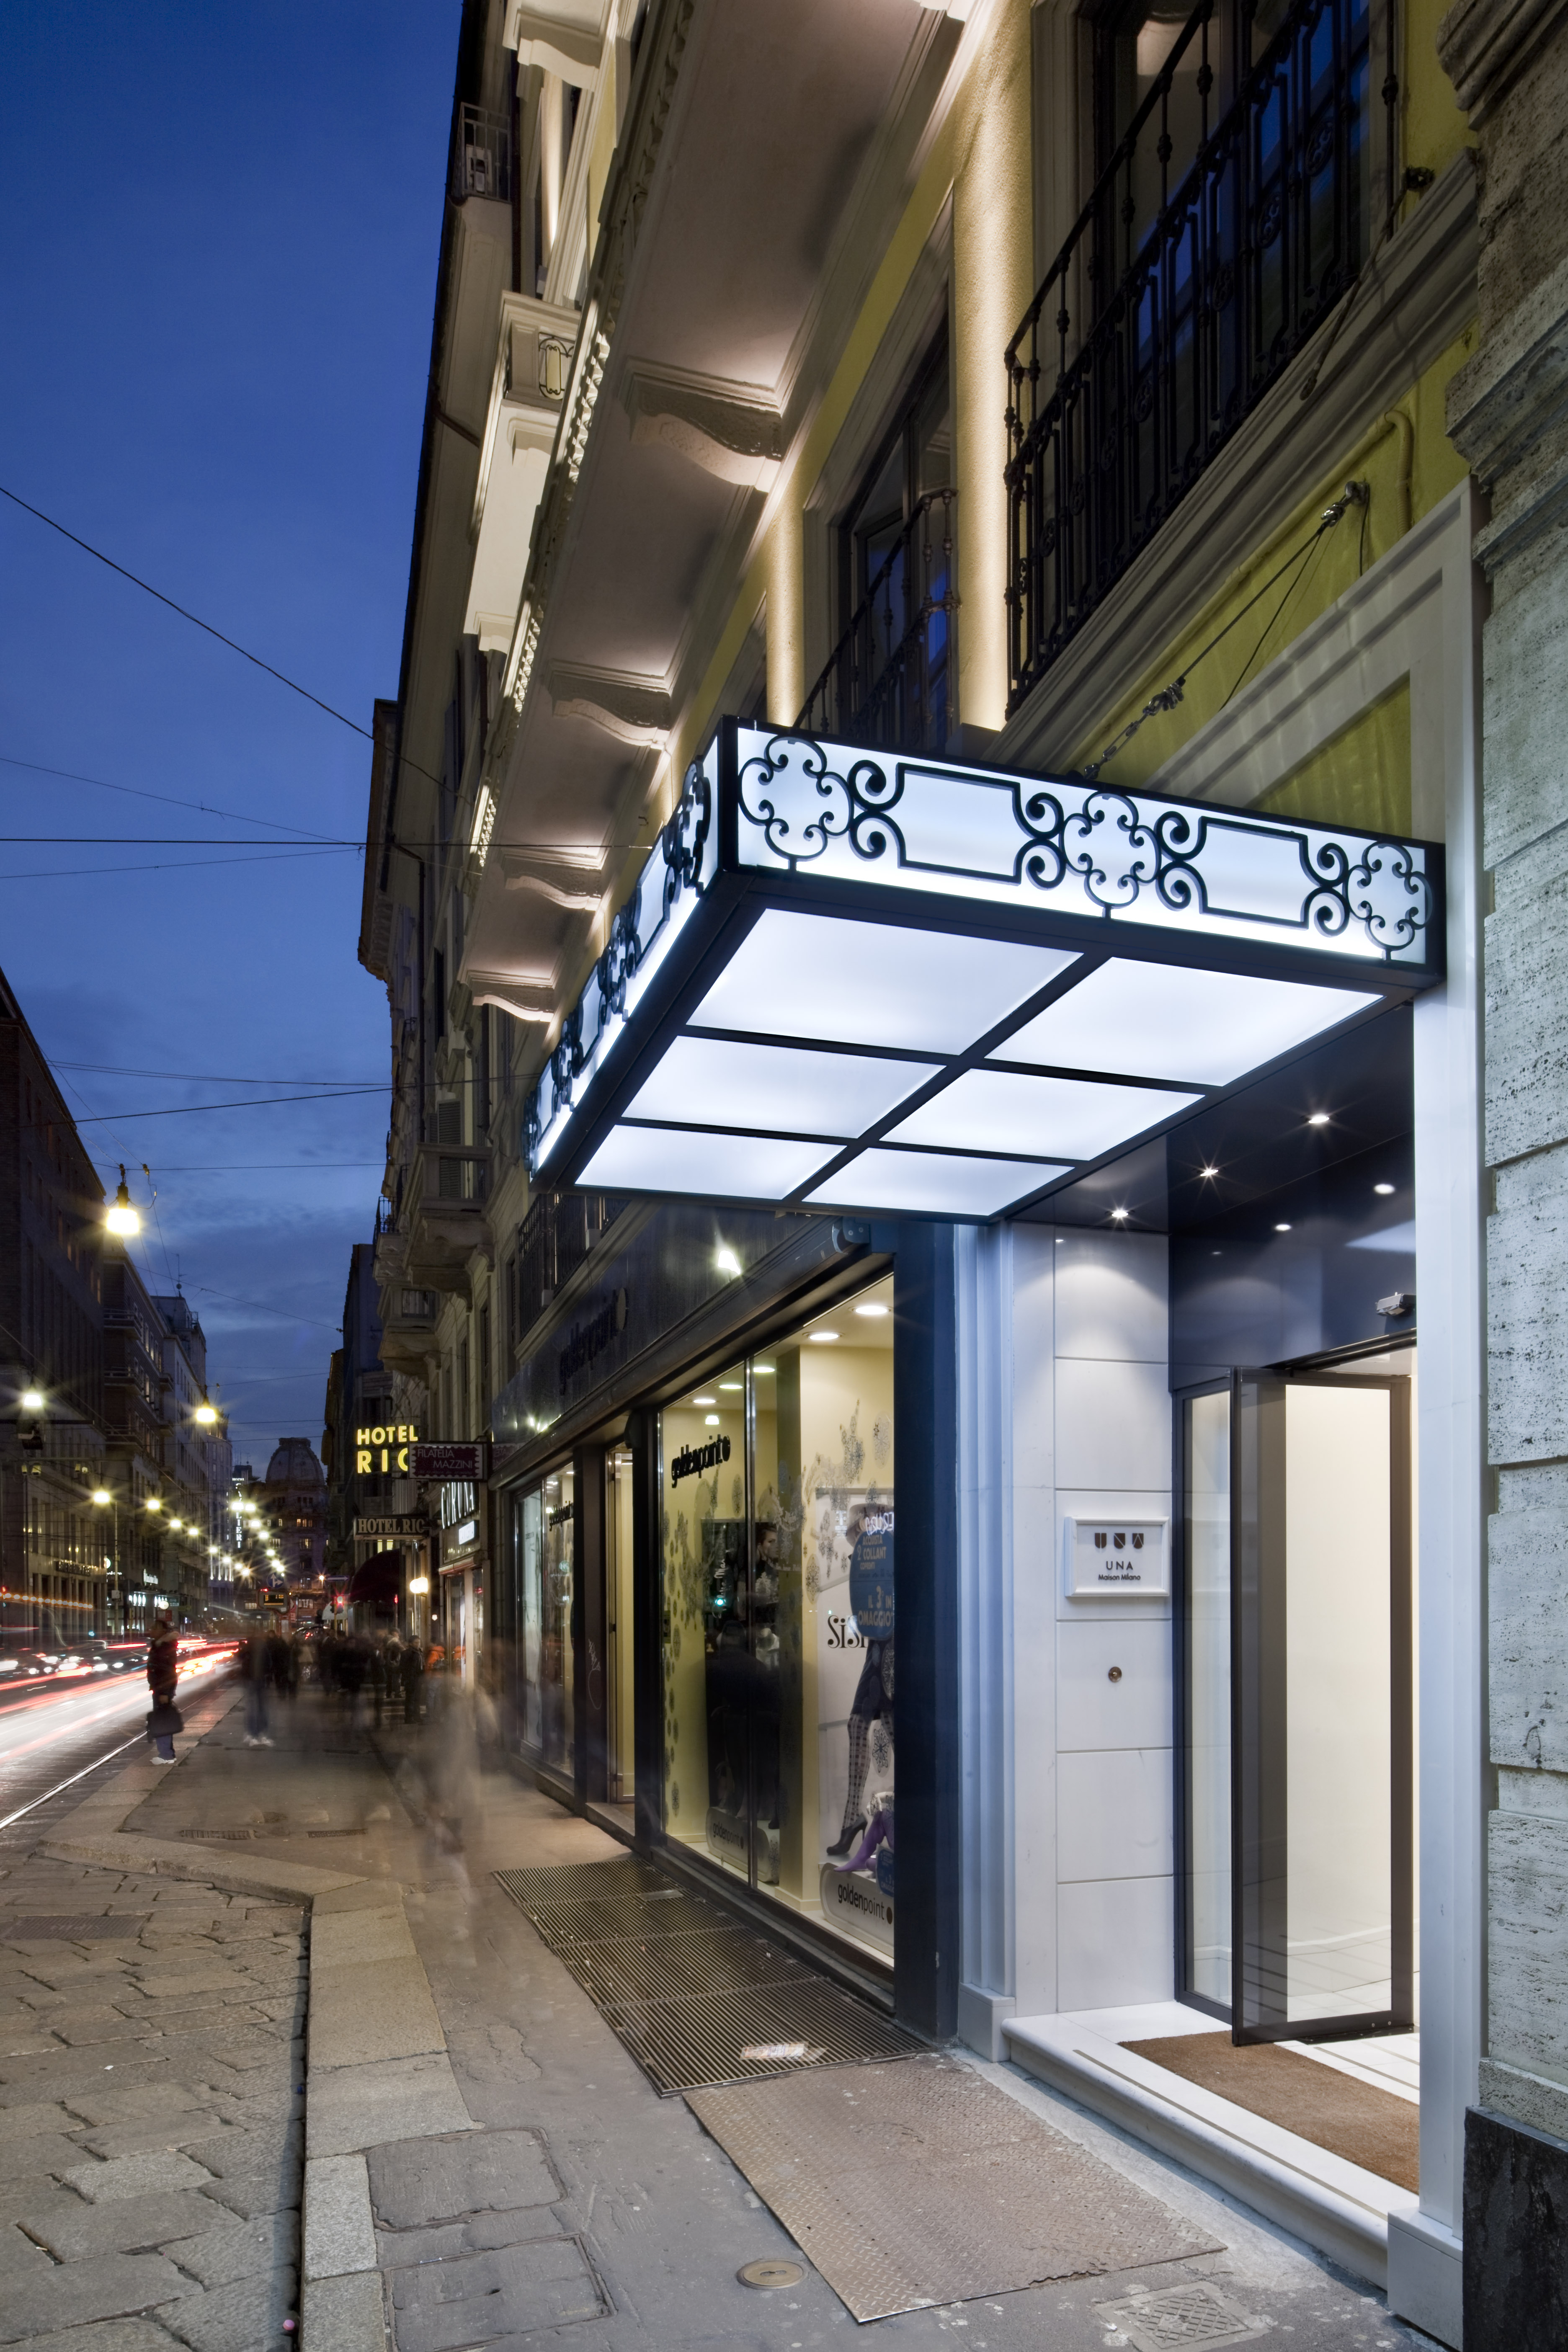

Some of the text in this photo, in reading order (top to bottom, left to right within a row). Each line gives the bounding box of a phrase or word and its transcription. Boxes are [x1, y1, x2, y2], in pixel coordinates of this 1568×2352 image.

[357, 1425, 418, 1445] HOTEL
[418, 1449, 454, 1458] FILATELIA
[433, 1460, 472, 1469] MAZZINI
[358, 1519, 400, 1533] HOTEL
[862, 1534, 882, 1545] ACQUISTA
[857, 1545, 887, 1561] 2 COLLANT
[1106, 1561, 1133, 1570] UNA
[868, 1595, 873, 1608] IL
[885, 1596, 892, 1609] IN
[838, 1883, 885, 1921] goldenpoint
